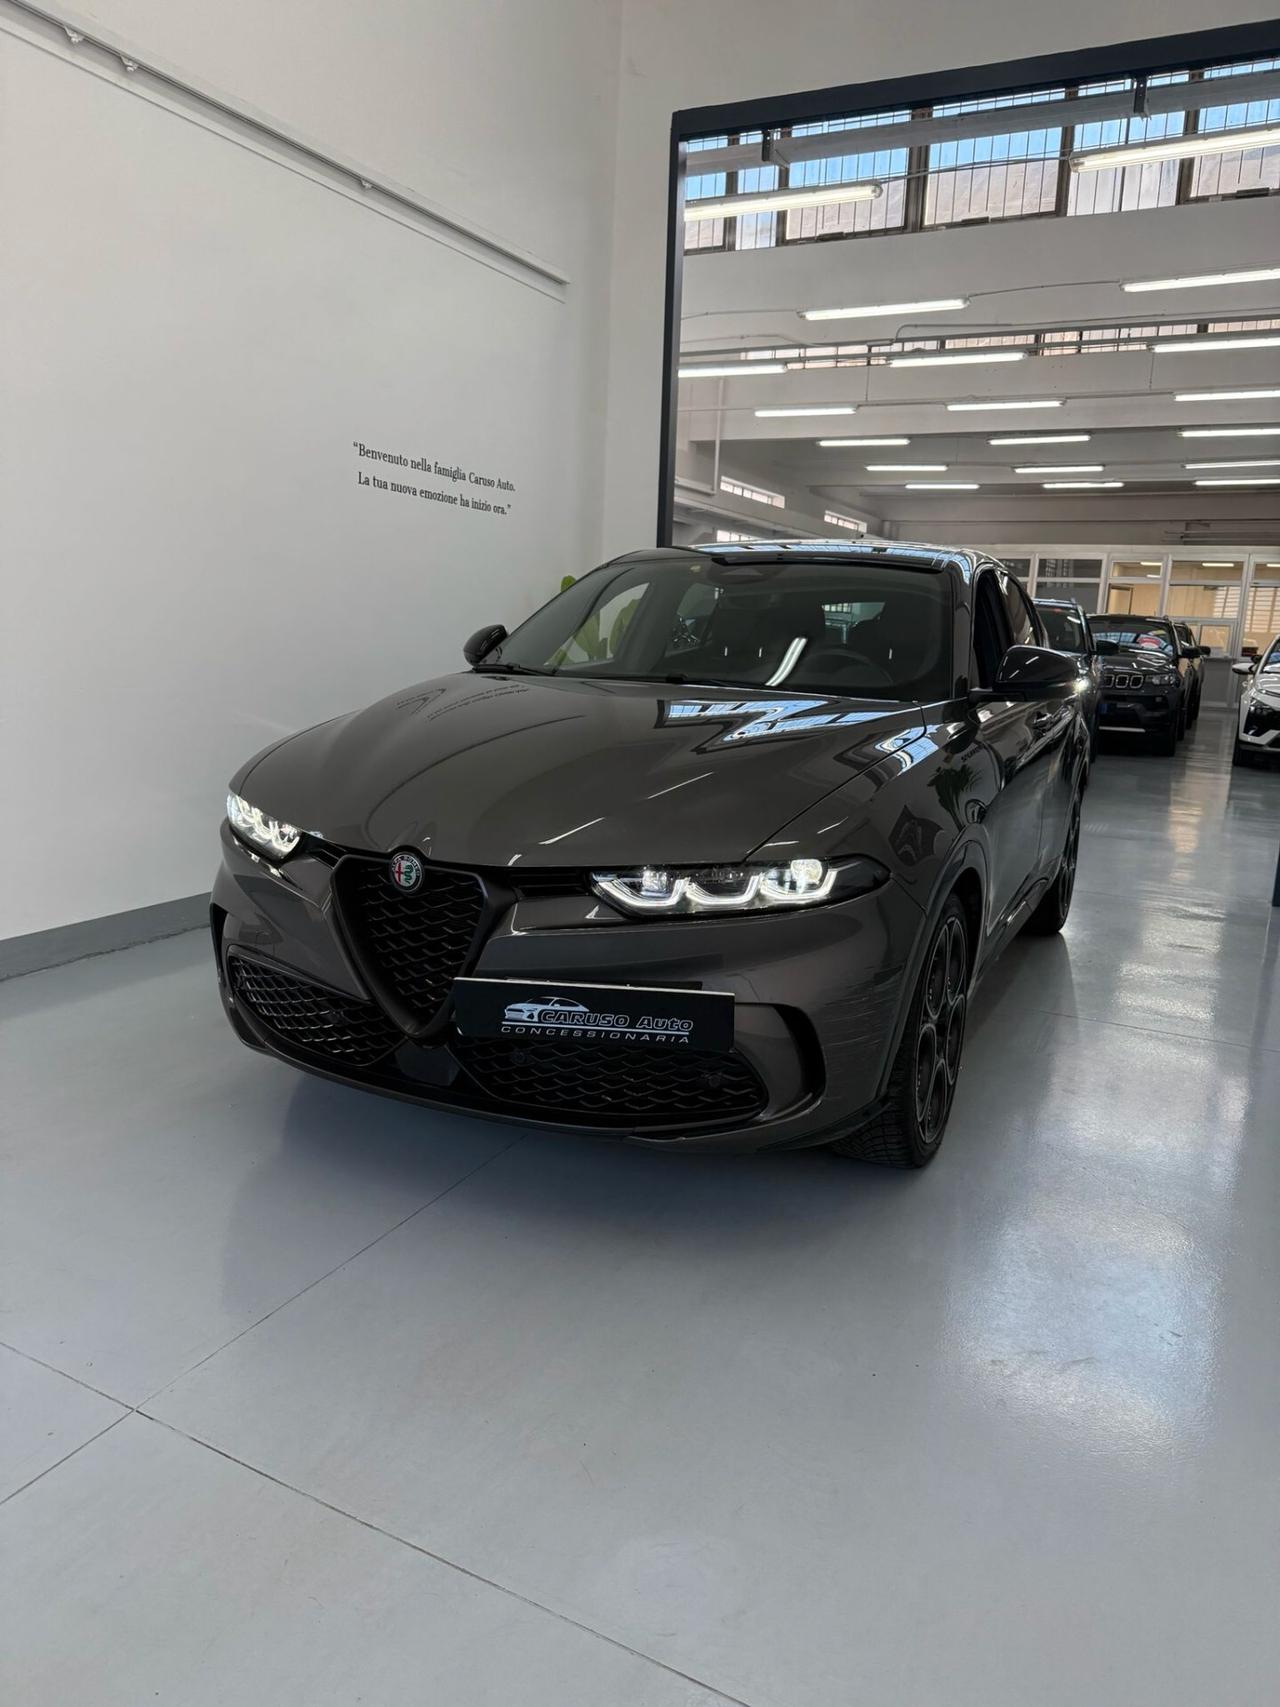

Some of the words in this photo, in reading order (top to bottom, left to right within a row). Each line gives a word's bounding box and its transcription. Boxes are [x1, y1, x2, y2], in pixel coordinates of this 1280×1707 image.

[410, 458, 432, 473] nella
[434, 461, 466, 482] famiglia
[468, 472, 495, 488] Caruso
[358, 471, 370, 486] La
[373, 475, 388, 490] tua
[390, 482, 418, 496] nuova
[419, 488, 458, 506] emozione
[460, 493, 470, 508] ha
[472, 498, 492, 512] inizio
[540, 1009, 630, 1028] CARUSO
[635, 1016, 693, 1032] Auto
[500, 1026, 690, 1044] CONCESSIONARIA
